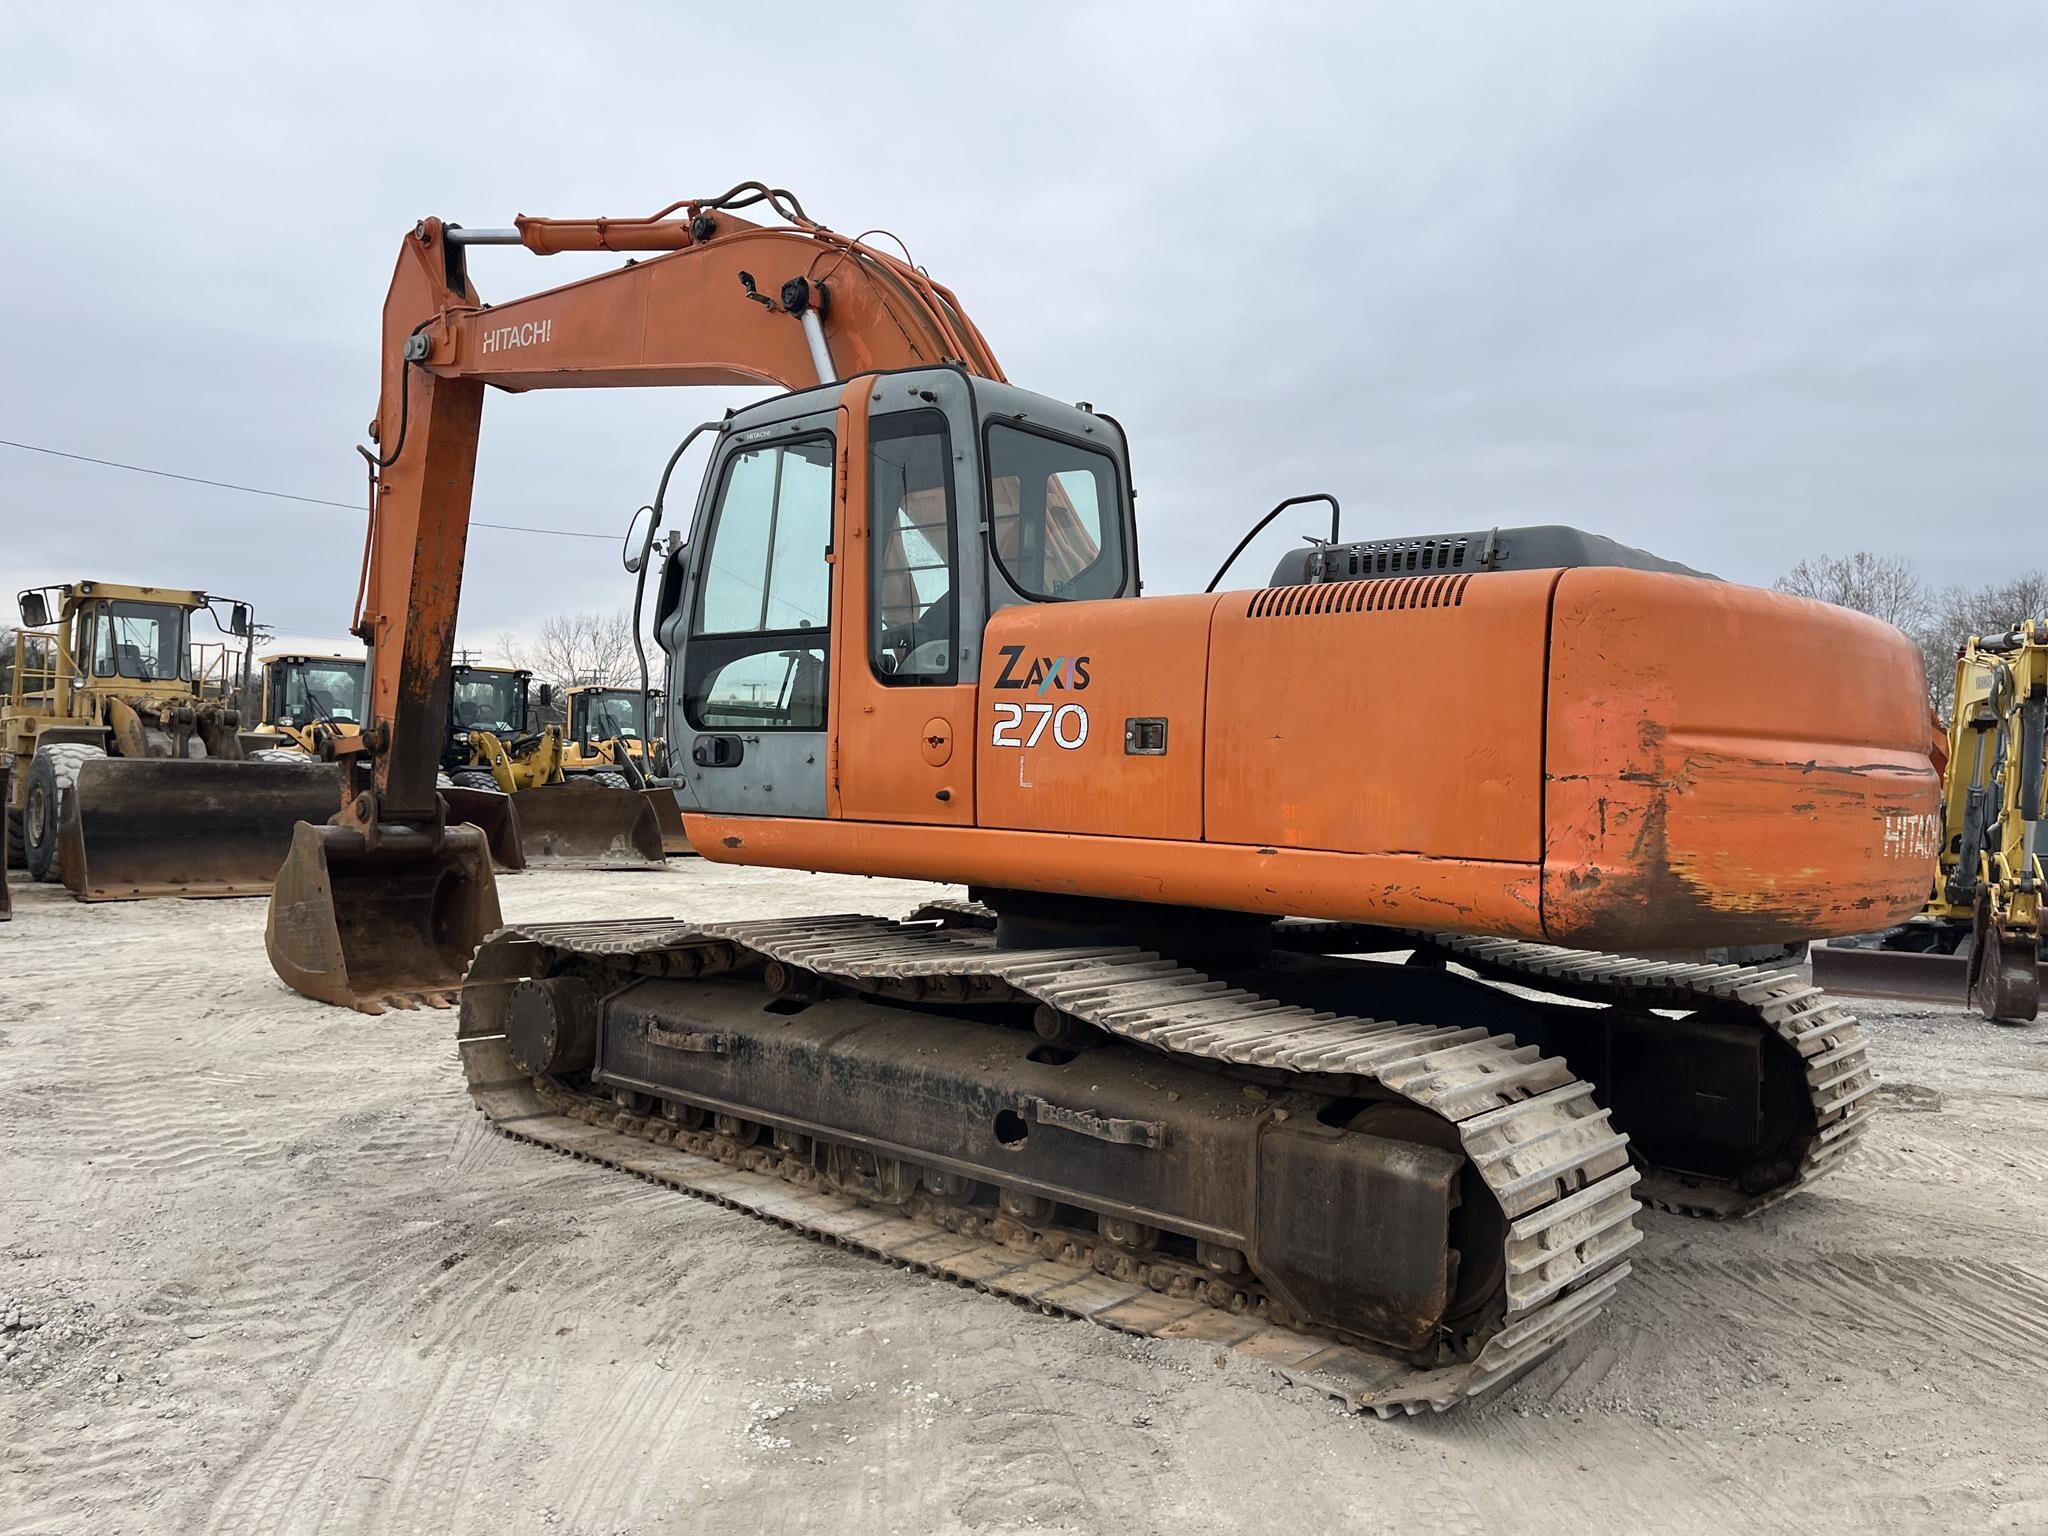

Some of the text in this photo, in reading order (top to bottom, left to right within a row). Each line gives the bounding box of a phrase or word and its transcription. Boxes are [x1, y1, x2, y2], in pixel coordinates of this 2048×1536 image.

[482, 319, 552, 354] HITACHI
[746, 431, 771, 441] HITACHI
[994, 645, 1090, 696] ZAXIS
[992, 702, 1089, 750] 270
